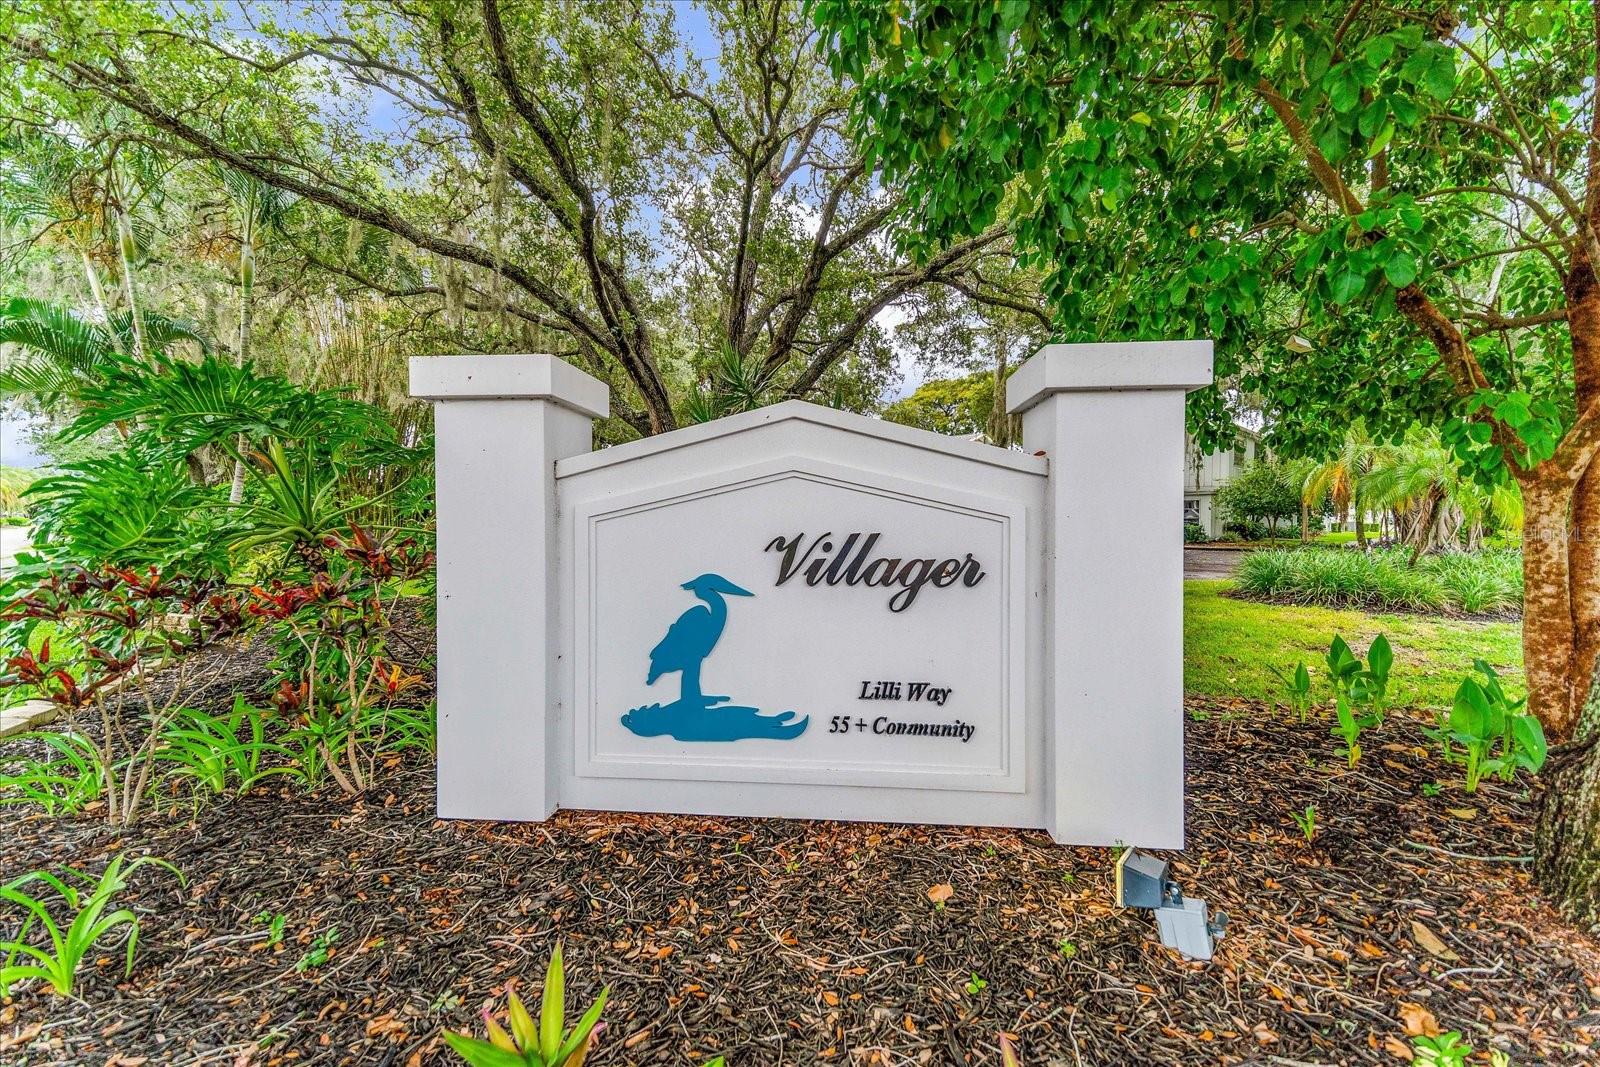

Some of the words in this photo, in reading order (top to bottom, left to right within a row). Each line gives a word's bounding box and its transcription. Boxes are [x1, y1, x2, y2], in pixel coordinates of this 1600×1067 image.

[763, 531, 987, 614] Villager
[857, 680, 902, 702] Lilli
[907, 682, 953, 707] Way
[828, 715, 851, 734] 55
[872, 716, 976, 744] Community
